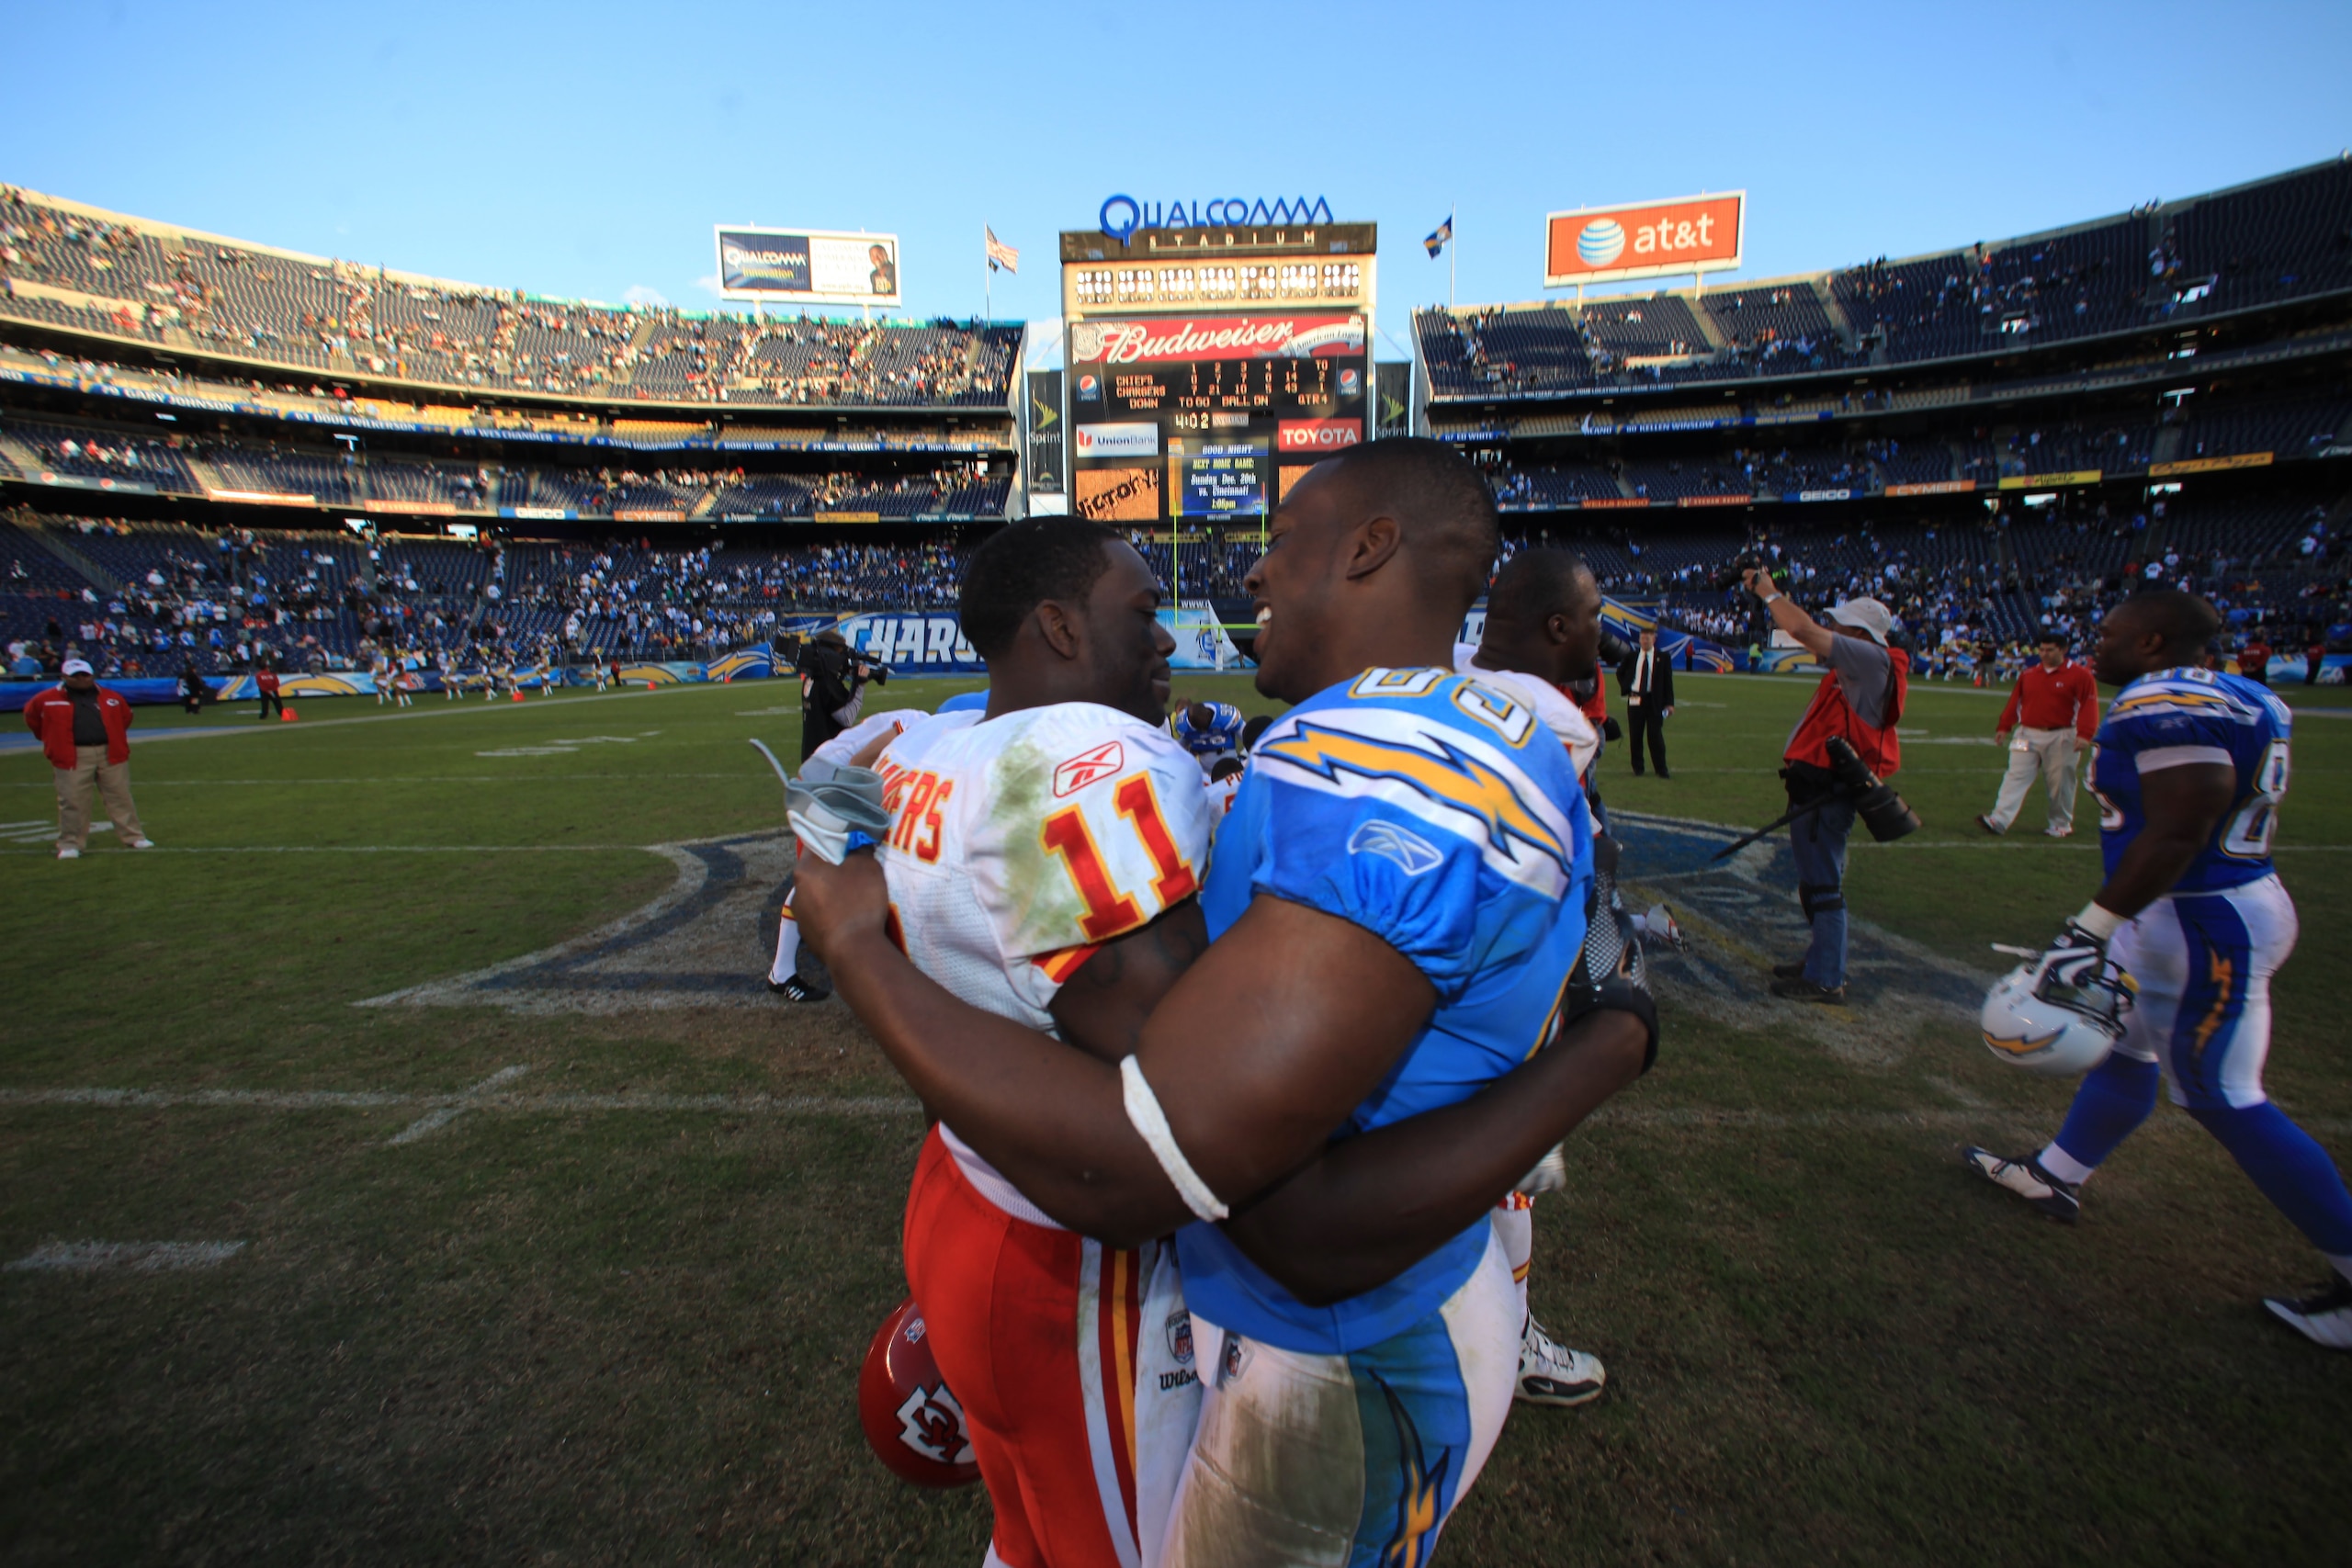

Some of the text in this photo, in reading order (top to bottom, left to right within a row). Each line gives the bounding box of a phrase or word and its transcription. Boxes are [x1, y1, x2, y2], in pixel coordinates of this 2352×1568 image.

[1100, 193, 1334, 248] QUALCOMM
[1149, 231, 1315, 249] STADIUM
[1634, 212, 1714, 254] at&t
[726, 251, 807, 269] QUALCOMM
[1103, 318, 1294, 364] Budweiser
[1115, 374, 1154, 387] CHIEFS
[124, 388, 165, 404] GARY
[167, 395, 235, 412] JOHNSON
[1129, 397, 1159, 409] DOWN
[1222, 395, 1250, 407] BALL
[1253, 394, 1269, 407] ON
[314, 412, 348, 426] DOUG
[349, 416, 417, 432] WILKERSON
[1175, 412, 1209, 429] 4:02
[1639, 423, 1669, 433] KELLEN
[1671, 420, 1715, 431] WINSLOW
[502, 428, 553, 442] CHANDLER
[1030, 431, 1061, 446] Sprint
[1283, 427, 1358, 446] TOYOTA
[1467, 431, 1494, 441] WHITE
[609, 438, 632, 449] STAN
[633, 440, 685, 451] HUMPHRIES
[1202, 444, 1253, 455] GOOD NIGHT
[1799, 489, 1850, 502] GEICO
[1896, 481, 1962, 496] CYMER
[1583, 499, 1649, 509] WELLS FARGO
[515, 508, 566, 519] GEICO
[622, 511, 680, 522] CYMER
[845, 617, 986, 663] CHARG
[1038, 770, 1196, 943] 11
[1159, 1369, 1199, 1391] Wilso
